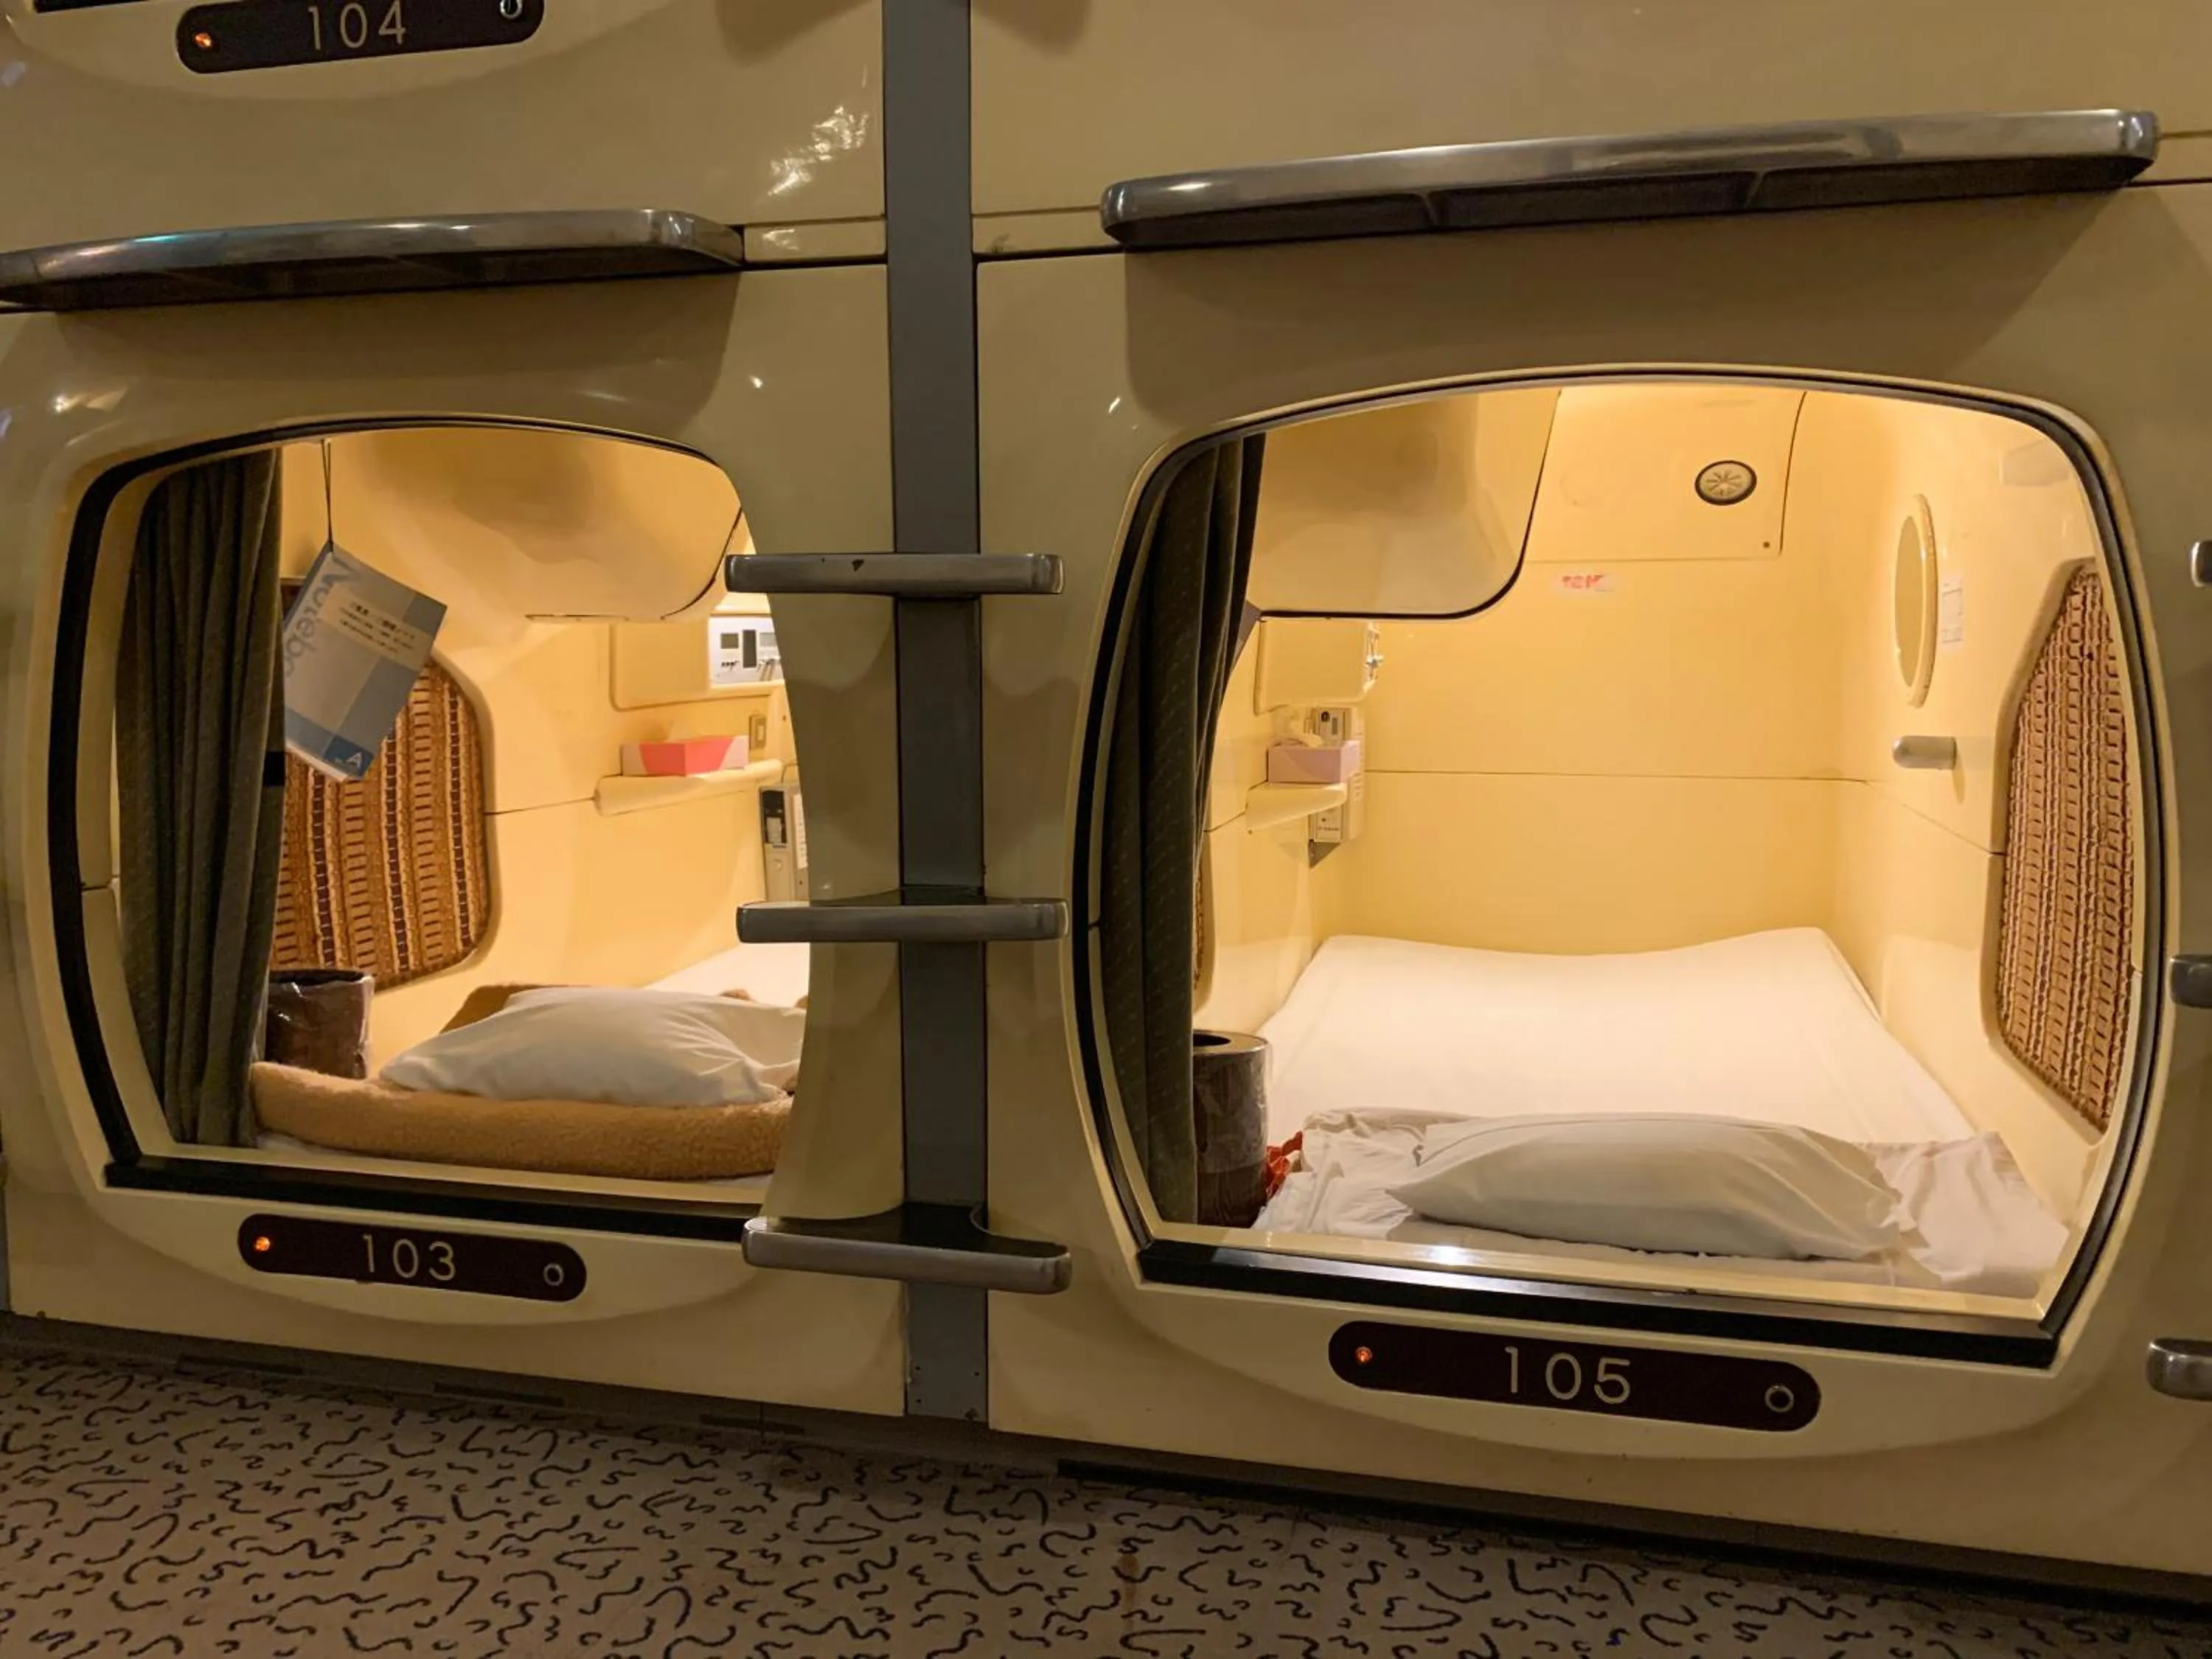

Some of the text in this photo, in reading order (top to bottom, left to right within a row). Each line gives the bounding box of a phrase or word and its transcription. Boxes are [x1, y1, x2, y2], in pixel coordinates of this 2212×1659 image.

[307, 0, 406, 50] 104
[363, 1234, 456, 1281] 103
[1505, 1346, 1632, 1404] 105
